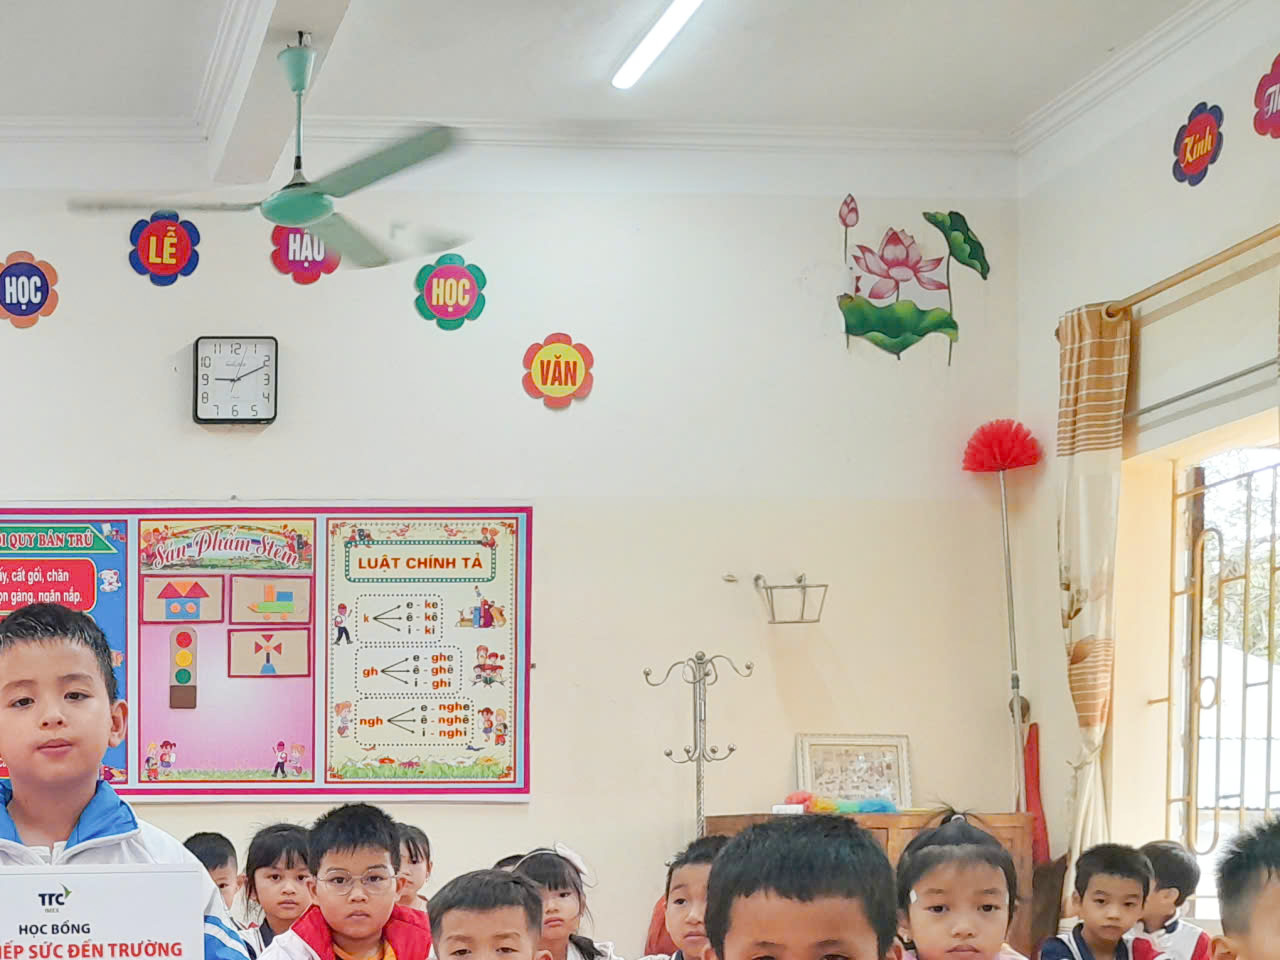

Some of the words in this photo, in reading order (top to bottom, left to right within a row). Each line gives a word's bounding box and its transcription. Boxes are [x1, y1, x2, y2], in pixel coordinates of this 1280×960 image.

[4, 275, 42, 310] HỌC
[149, 226, 178, 265] LỄ
[288, 229, 325, 268] HẬU
[431, 278, 470, 313] HỌC
[539, 354, 578, 387] VĂN
[214, 343, 222, 354] 11
[231, 342, 241, 355] 12
[200, 356, 211, 368] 10
[263, 355, 271, 367] 2
[201, 373, 209, 386] 9
[263, 373, 270, 386] 3
[201, 391, 209, 404] 8
[262, 392, 270, 404] 4
[212, 405, 220, 416] 7
[231, 404, 239, 417] 6
[251, 404, 258, 417] 5
[8, 532, 35, 550] QUY
[256, 535, 299, 568] Stem
[358, 554, 401, 573] LUẬT
[406, 554, 456, 569] CHÍNH
[461, 552, 483, 569] TẢ
[406, 602, 414, 610] e
[424, 600, 438, 610] ke
[363, 613, 370, 623] k
[424, 612, 438, 622] kê
[424, 625, 436, 635] ki
[413, 654, 420, 662] e
[431, 652, 454, 664] ghe
[362, 666, 379, 678] gh
[431, 665, 454, 677] ghê
[432, 678, 452, 690] ghi
[420, 704, 428, 712] e
[438, 701, 470, 713] nghe
[360, 716, 384, 728] ngh
[438, 714, 470, 726] nghê
[439, 727, 467, 739] nghi
[38, 893, 65, 907] TTC
[18, 924, 48, 939] HỌC
[28, 940, 64, 959] SỨC
[67, 938, 104, 959] ĐẾN
[108, 940, 184, 959] TRƯỜNG
